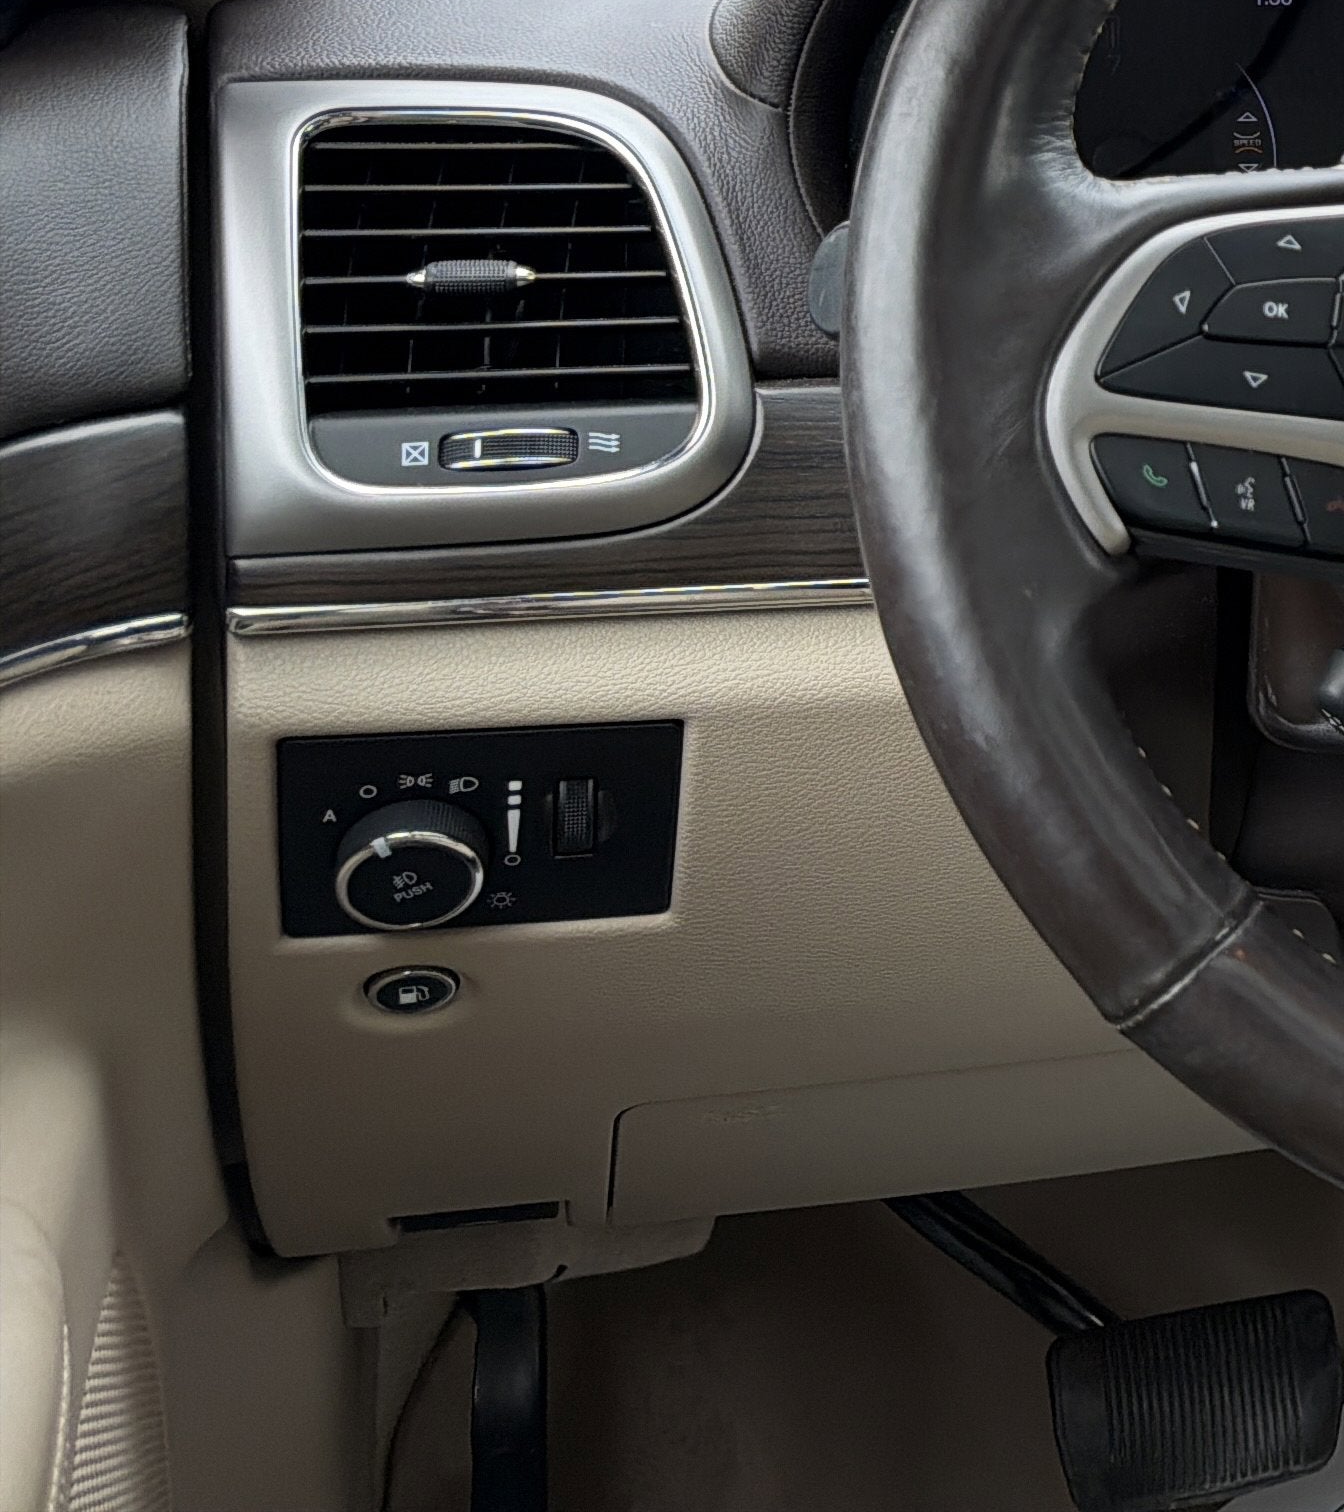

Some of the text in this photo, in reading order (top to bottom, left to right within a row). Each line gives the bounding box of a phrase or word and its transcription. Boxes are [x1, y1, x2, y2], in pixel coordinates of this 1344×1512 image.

[1262, 301, 1289, 318] OK
[321, 808, 338, 824] A
[392, 881, 434, 903] PUSH
